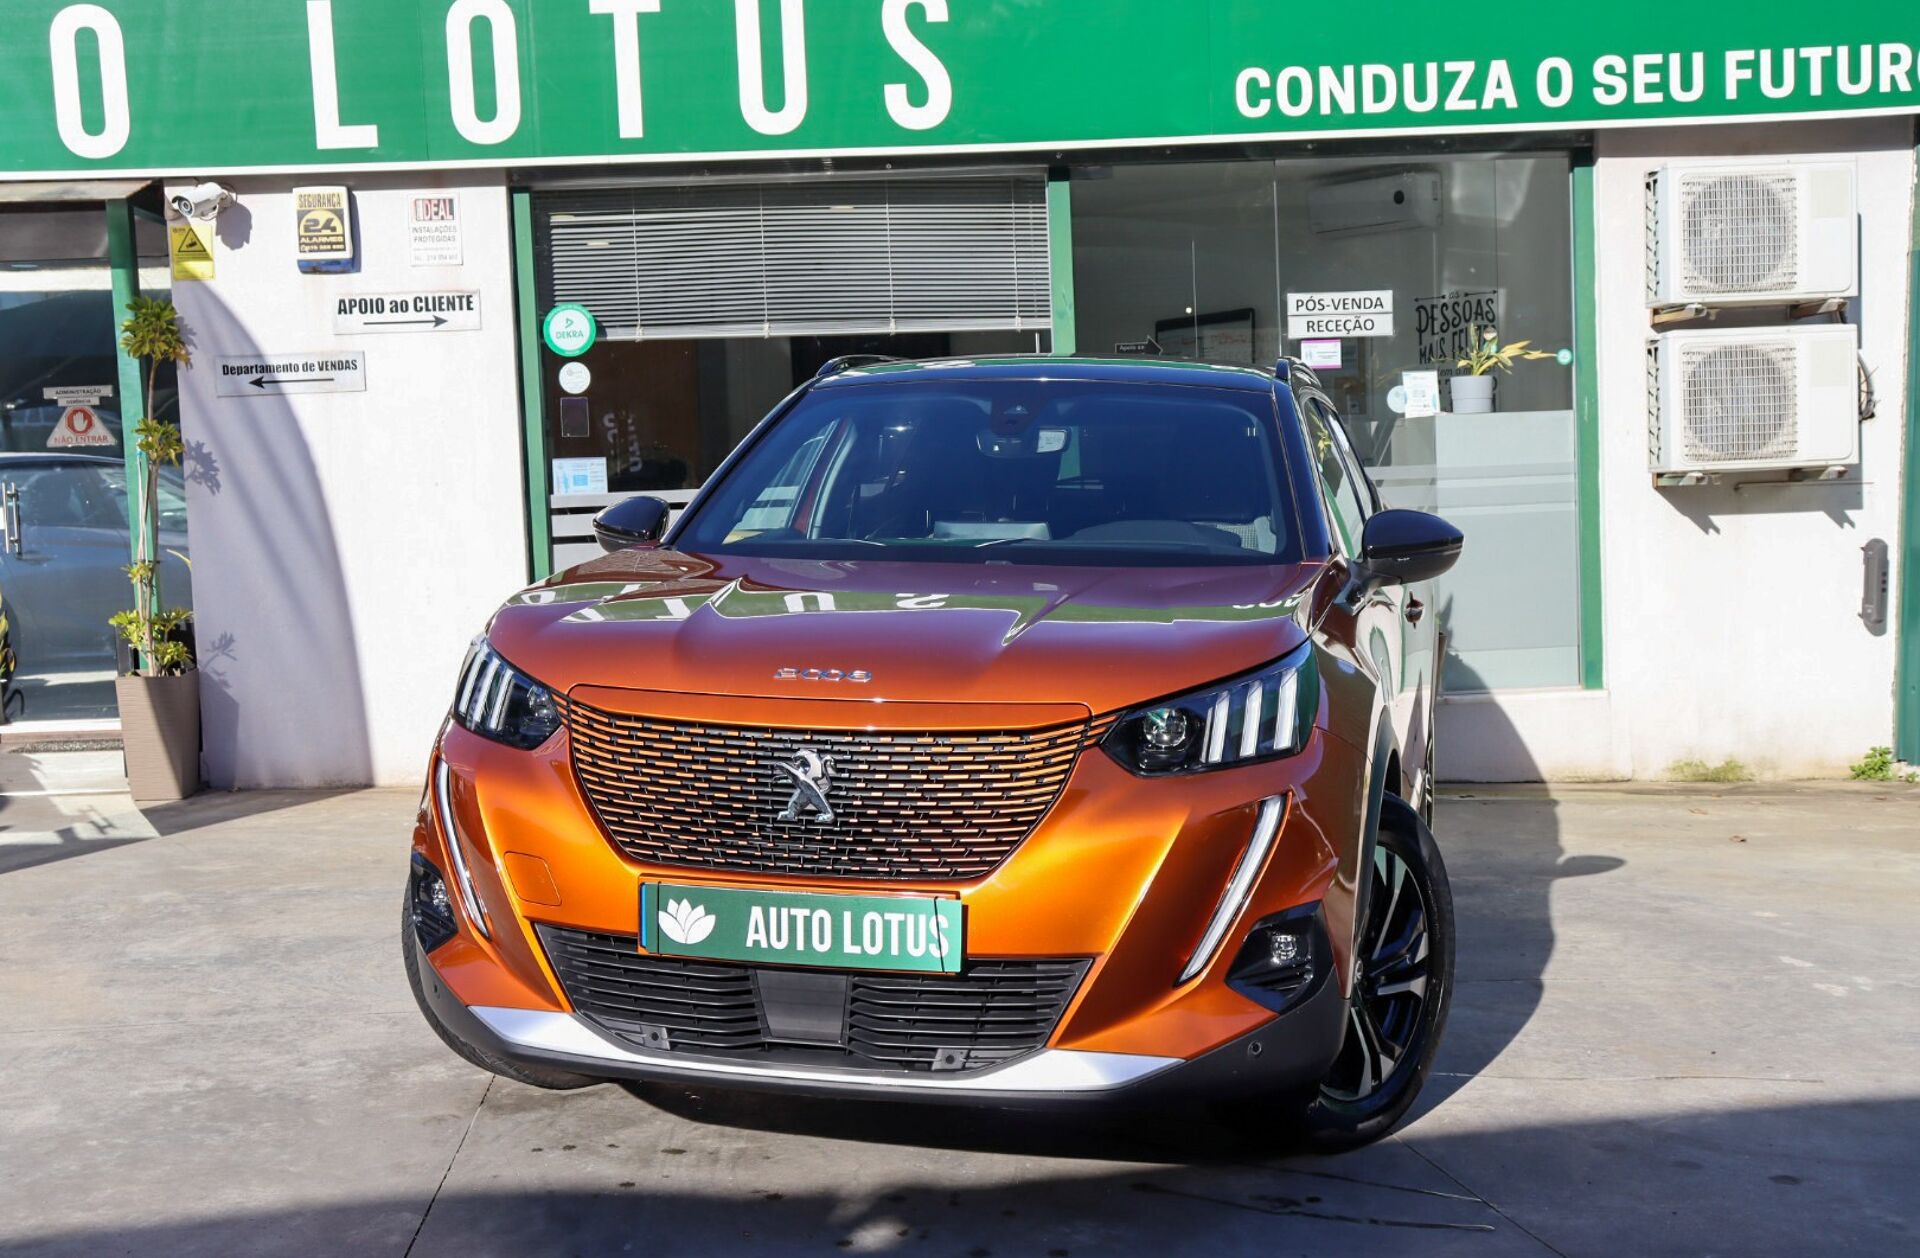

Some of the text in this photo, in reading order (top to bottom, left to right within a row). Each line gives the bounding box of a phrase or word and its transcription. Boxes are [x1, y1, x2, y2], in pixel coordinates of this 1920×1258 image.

[306, 0, 953, 149] LOTUS
[1235, 42, 1920, 118] CONDUZA O SEU FUTUR
[303, 218, 337, 232] 24
[337, 295, 474, 315] APOIO ao CLIENTE
[1296, 296, 1384, 312] PÓS-VENDA
[1306, 315, 1375, 335] RECEÇÃO
[1415, 298, 1496, 346] PESSOAS
[556, 330, 584, 340] DEKRA
[222, 359, 358, 376] Departamento de VENDAS
[54, 434, 109, 445] NÃO ENTRAR
[773, 667, 872, 684] 2008
[745, 905, 950, 959] AUTO LOTUS
